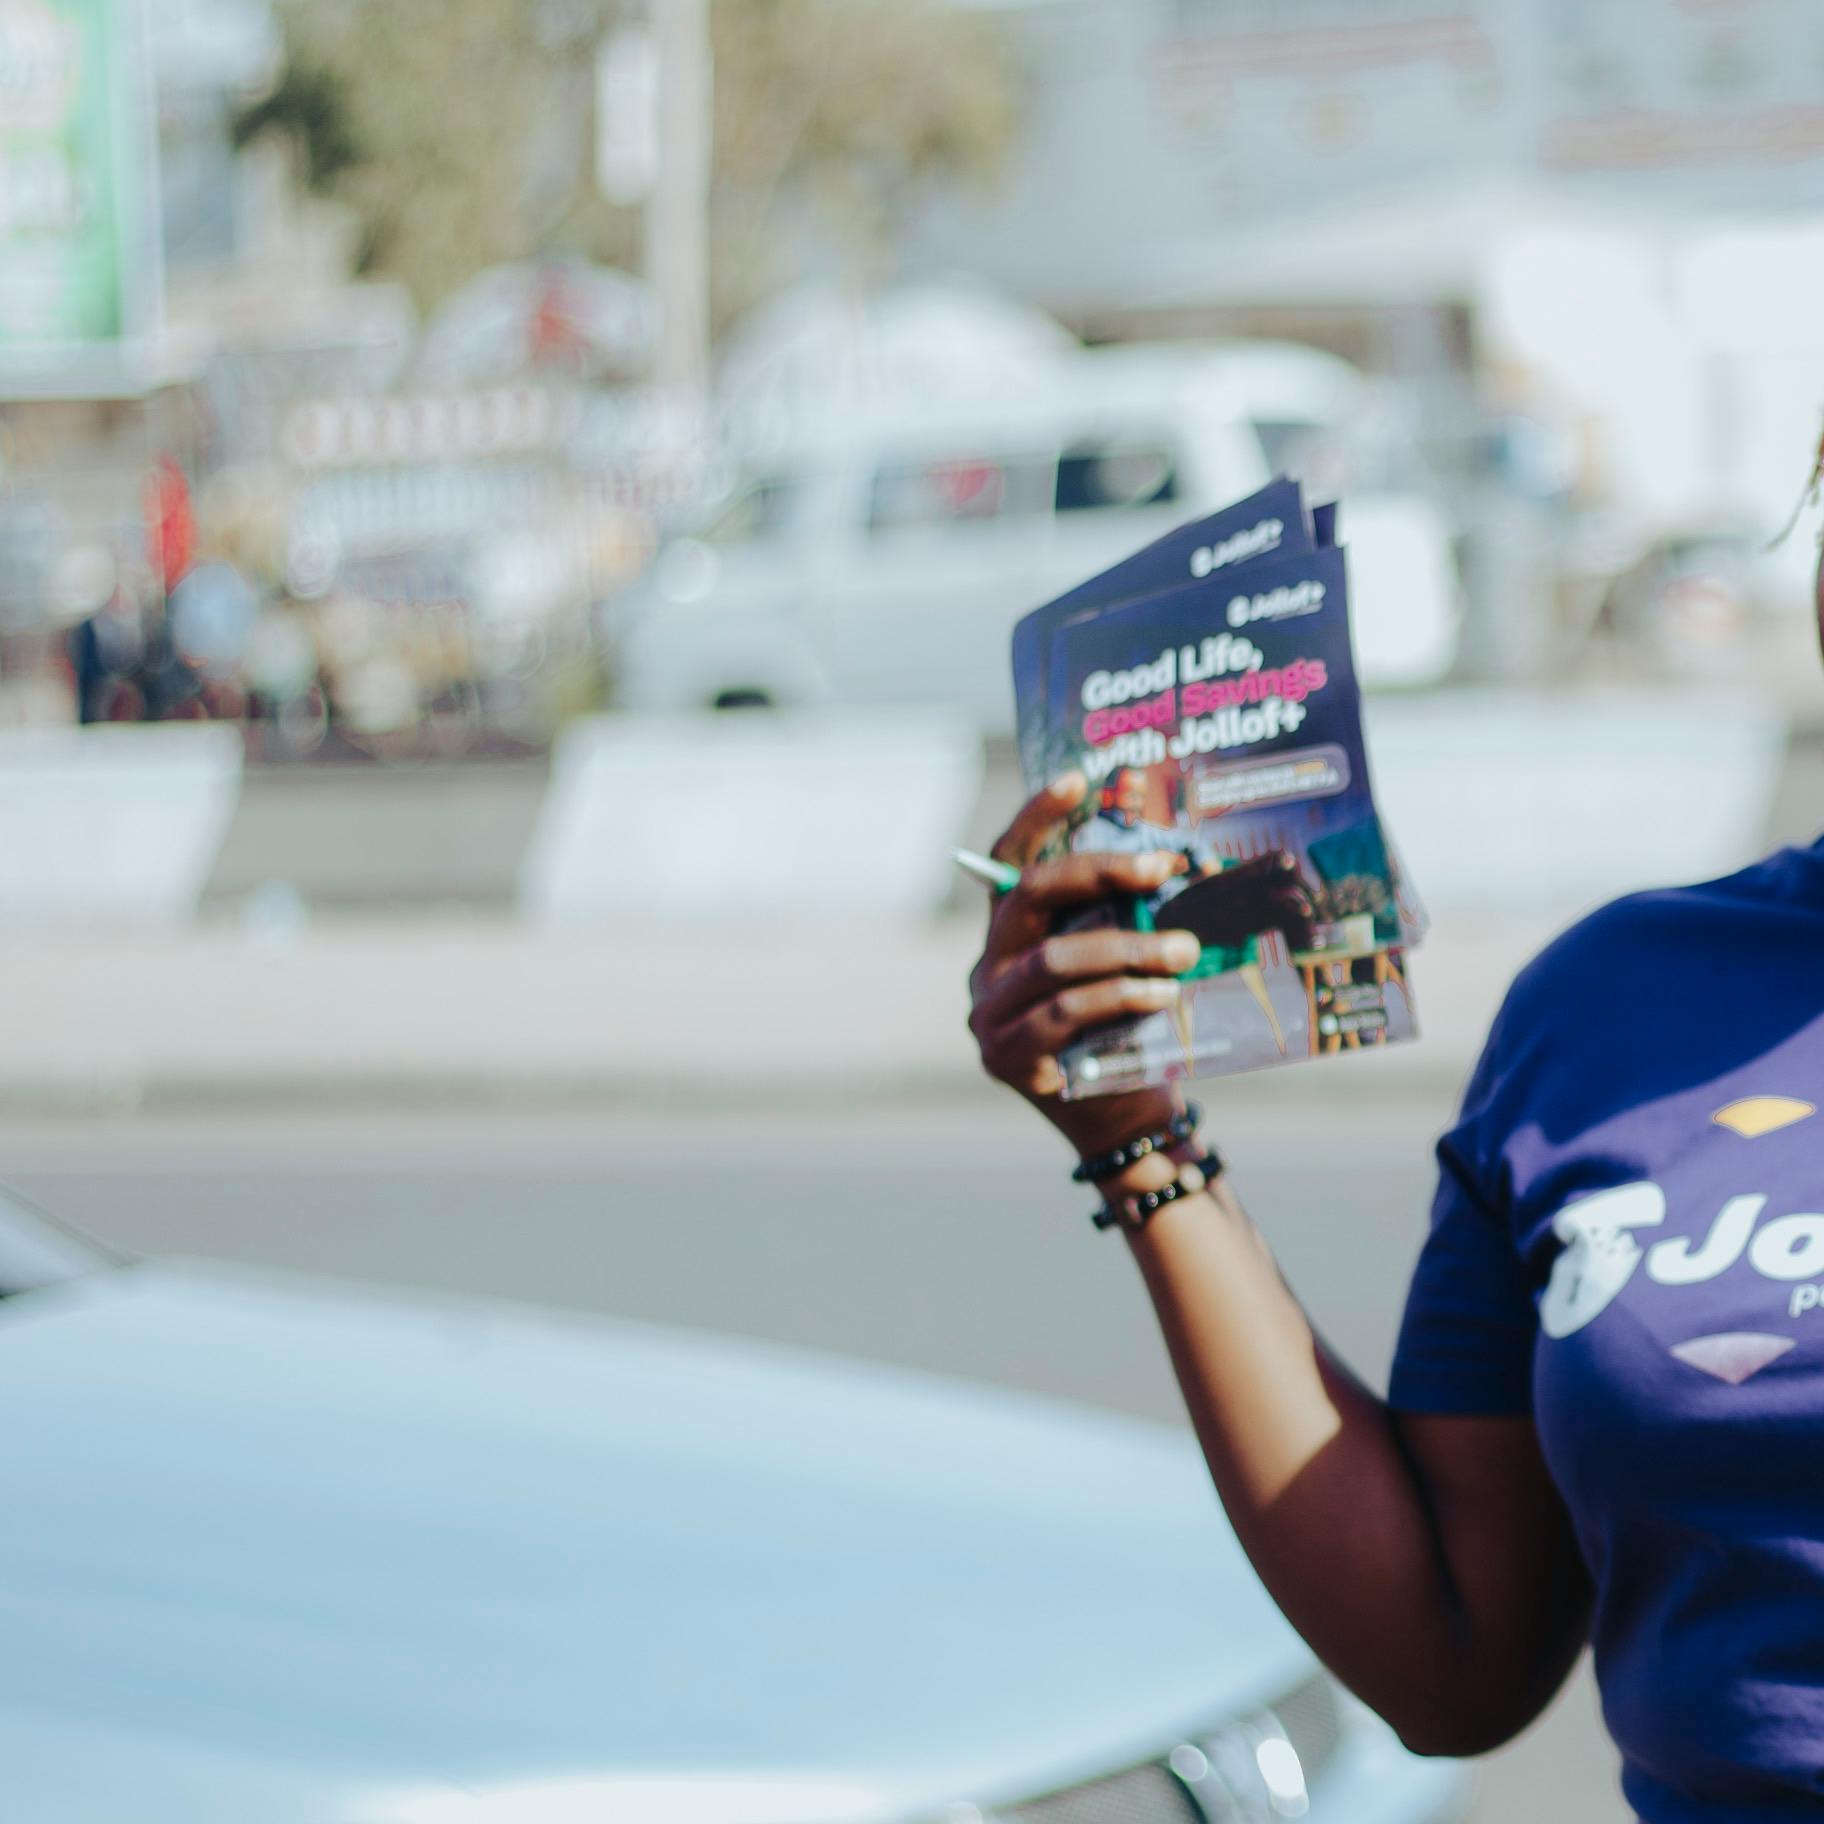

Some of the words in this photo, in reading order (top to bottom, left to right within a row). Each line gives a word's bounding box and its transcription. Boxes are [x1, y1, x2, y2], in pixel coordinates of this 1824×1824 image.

[1081, 648, 1177, 711] Good
[1179, 632, 1264, 684] Life,
[1083, 688, 1176, 747] Good
[1181, 657, 1328, 717] Savings
[1082, 726, 1167, 781] with
[1168, 695, 1307, 759] Jollof+
